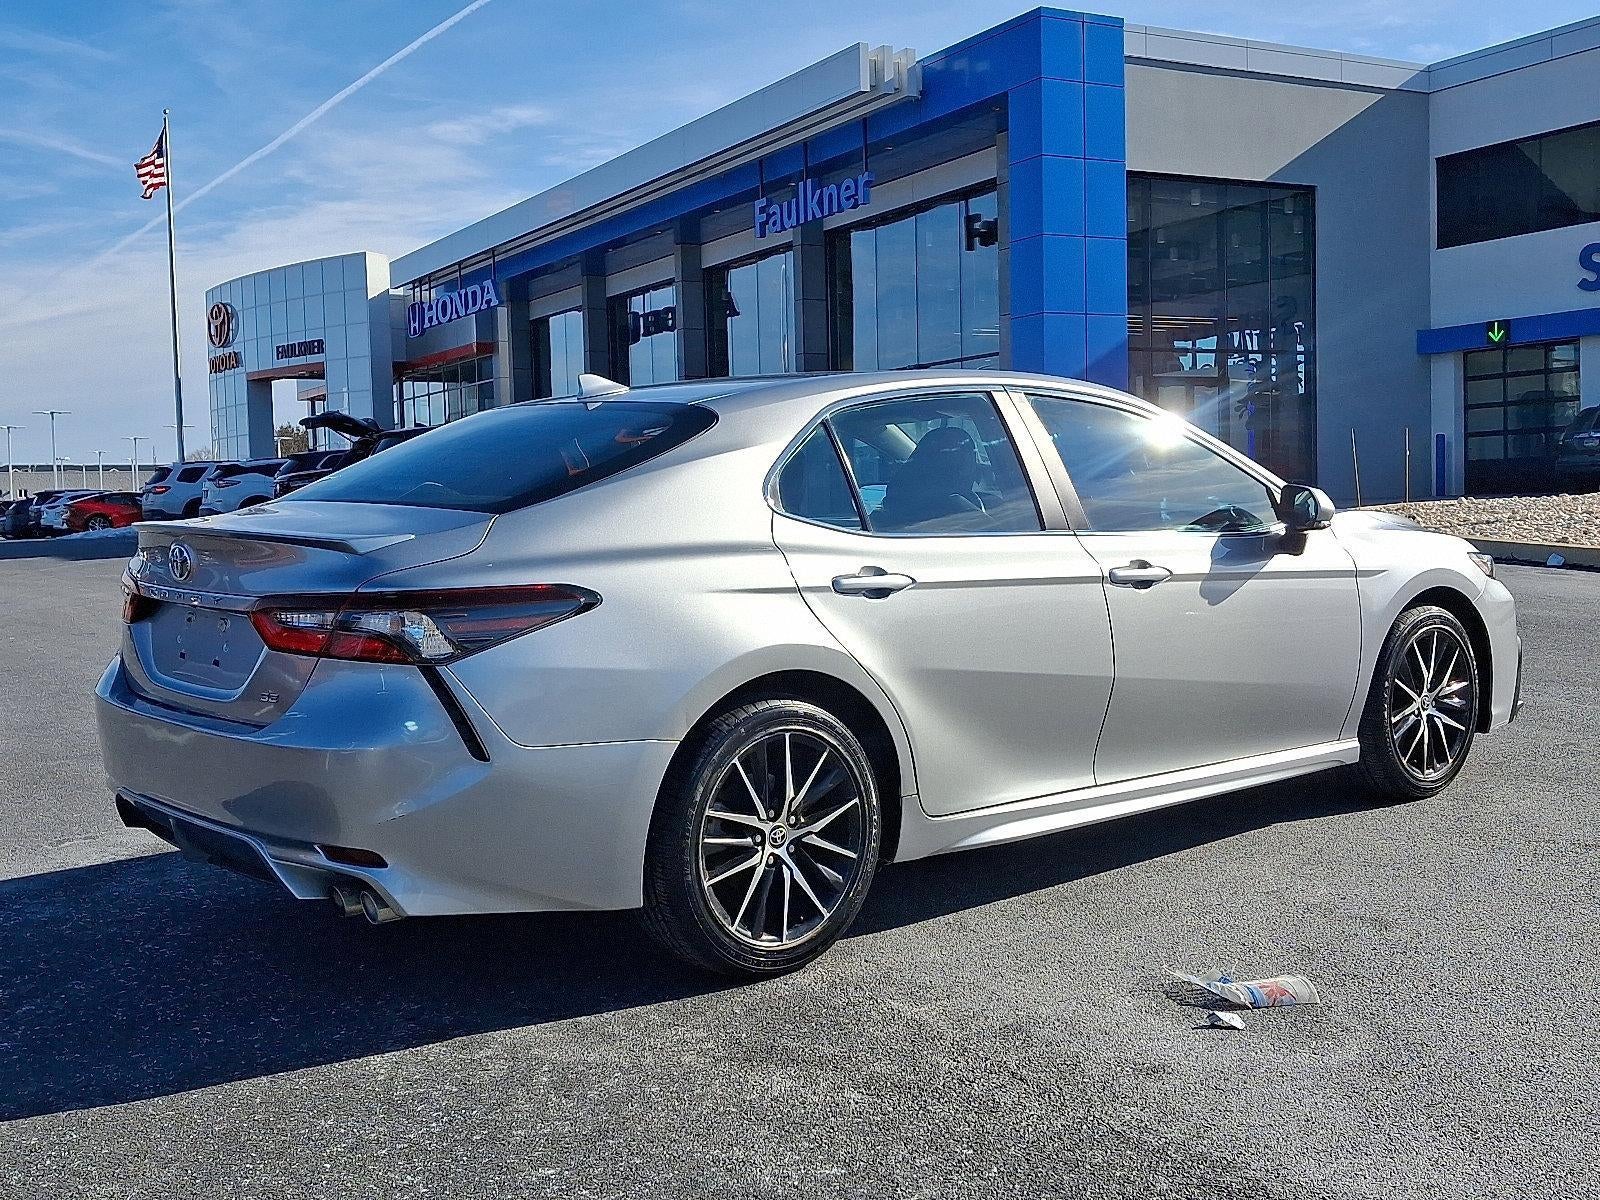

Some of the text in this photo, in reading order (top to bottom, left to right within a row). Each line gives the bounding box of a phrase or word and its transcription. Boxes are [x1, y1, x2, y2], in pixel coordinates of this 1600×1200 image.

[754, 171, 874, 238] Faulkner
[423, 279, 499, 329] HONDA
[276, 338, 325, 360] FAULKNER
